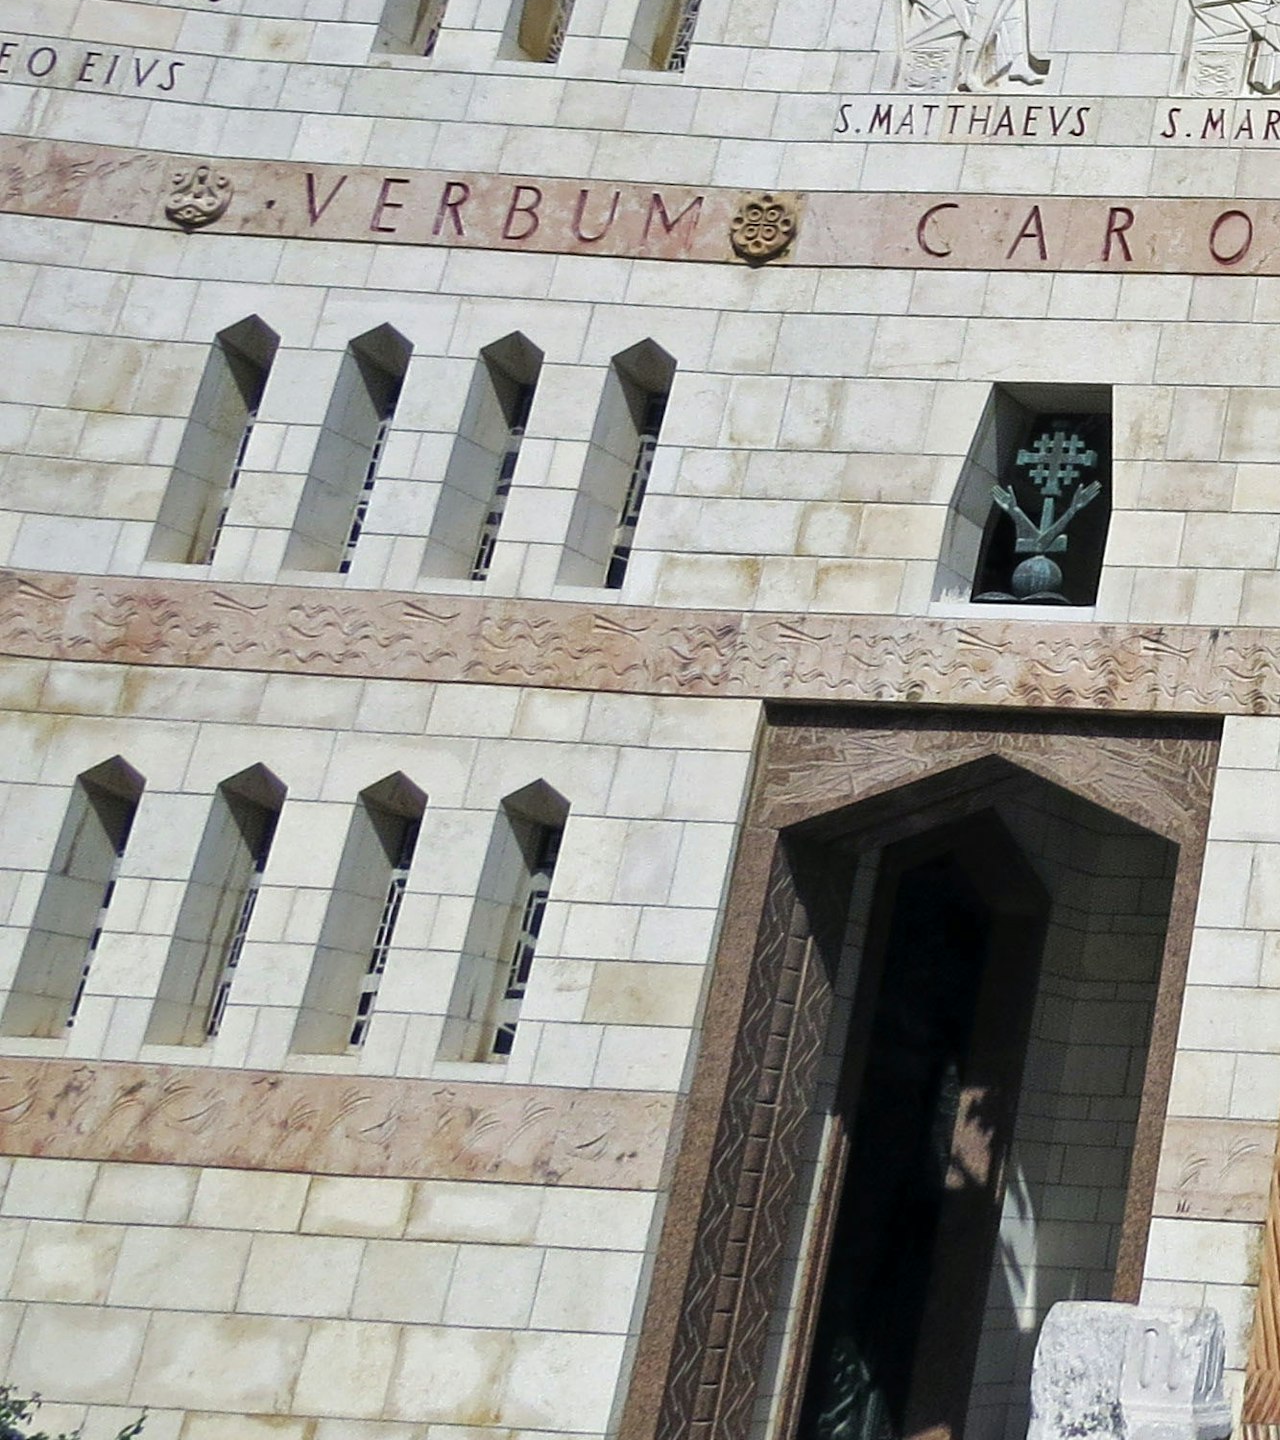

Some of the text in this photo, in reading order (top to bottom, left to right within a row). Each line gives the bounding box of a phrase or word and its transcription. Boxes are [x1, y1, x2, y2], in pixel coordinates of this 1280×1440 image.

[77, 51, 185, 91] EIVS
[305, 172, 705, 249] VERBUM
[916, 202, 1254, 266] CARO
